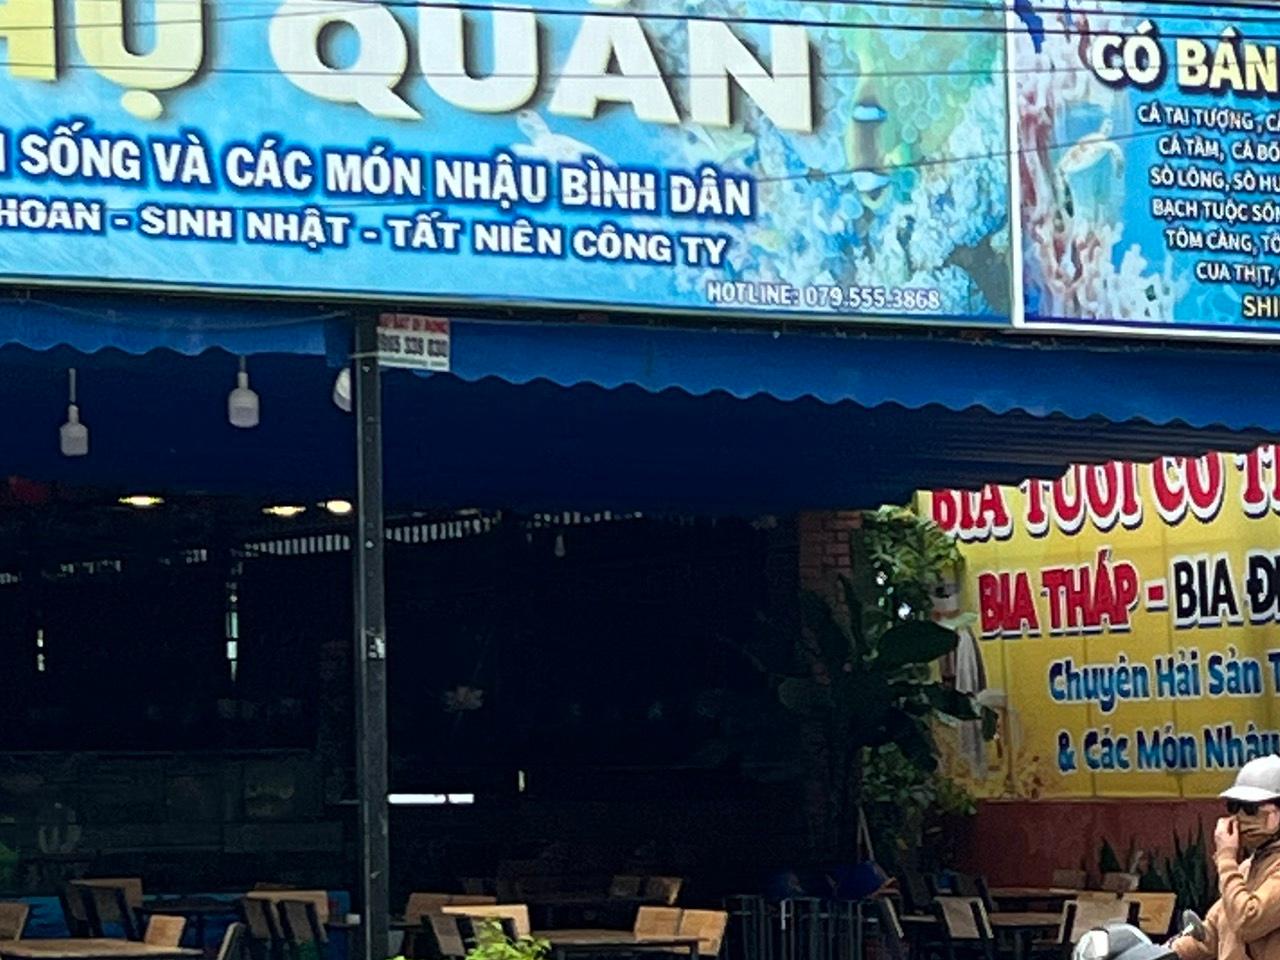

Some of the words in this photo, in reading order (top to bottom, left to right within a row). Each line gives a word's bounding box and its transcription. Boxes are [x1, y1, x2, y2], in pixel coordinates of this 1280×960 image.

[1091, 21, 1162, 87] CÓ
[1138, 101, 1161, 124] CÁ
[1164, 105, 1190, 125] TAI
[20, 121, 141, 181] SỐNG
[152, 134, 212, 184] VÀ
[226, 139, 312, 190] CÁC
[327, 146, 421, 197] MÓN
[435, 154, 547, 209] NHẬU
[561, 160, 656, 210] BÌNH
[670, 168, 751, 216] DÂN
[1159, 132, 1181, 155] CÁ
[1232, 139, 1254, 160] CÁ
[140, 205, 233, 239] SINH
[247, 209, 350, 248] NHẬT
[387, 212, 461, 250] TẤT
[474, 219, 561, 255] NIÊN
[573, 225, 673, 264] CÔNG
[681, 236, 727, 265] TY
[1166, 227, 1203, 249] TÔM
[707, 282, 800, 307] HOTLINE:
[806, 284, 940, 310] 079.555.3868
[1196, 262, 1231, 281] CUA
[976, 569, 1038, 638] BIA
[1041, 547, 1139, 636] THÁP
[1173, 555, 1240, 629] BIA
[1049, 658, 1150, 712] Chuyên
[1156, 647, 1203, 699] Hải
[1209, 645, 1263, 696] Sản
[1056, 735, 1077, 772] &
[1083, 727, 1131, 772] Các
[1136, 722, 1197, 769] Món
